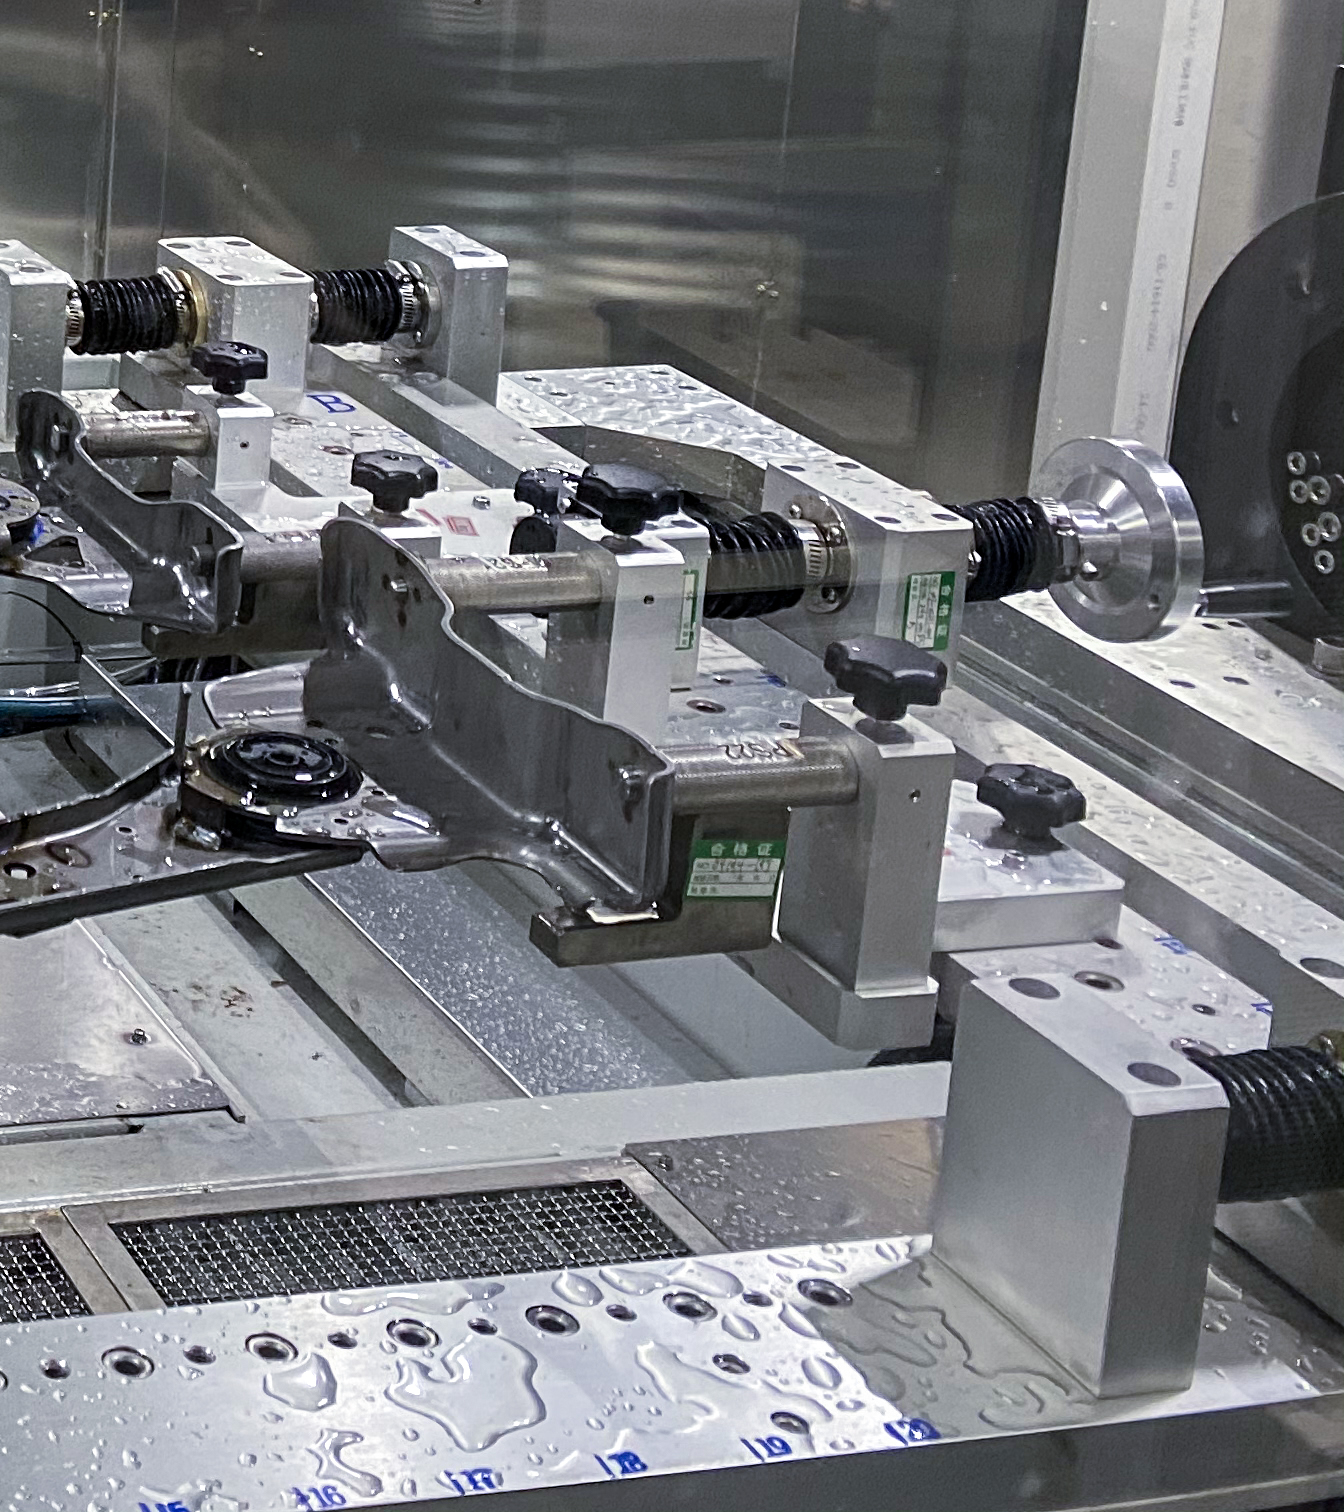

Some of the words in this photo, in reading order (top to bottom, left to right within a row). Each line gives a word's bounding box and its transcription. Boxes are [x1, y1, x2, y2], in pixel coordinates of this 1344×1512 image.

[310, 395, 356, 413] B
[711, 843, 773, 856] 合格证
[756, 1437, 792, 1458] 19
[609, 1452, 648, 1474] 18
[312, 1487, 347, 1508] 16
